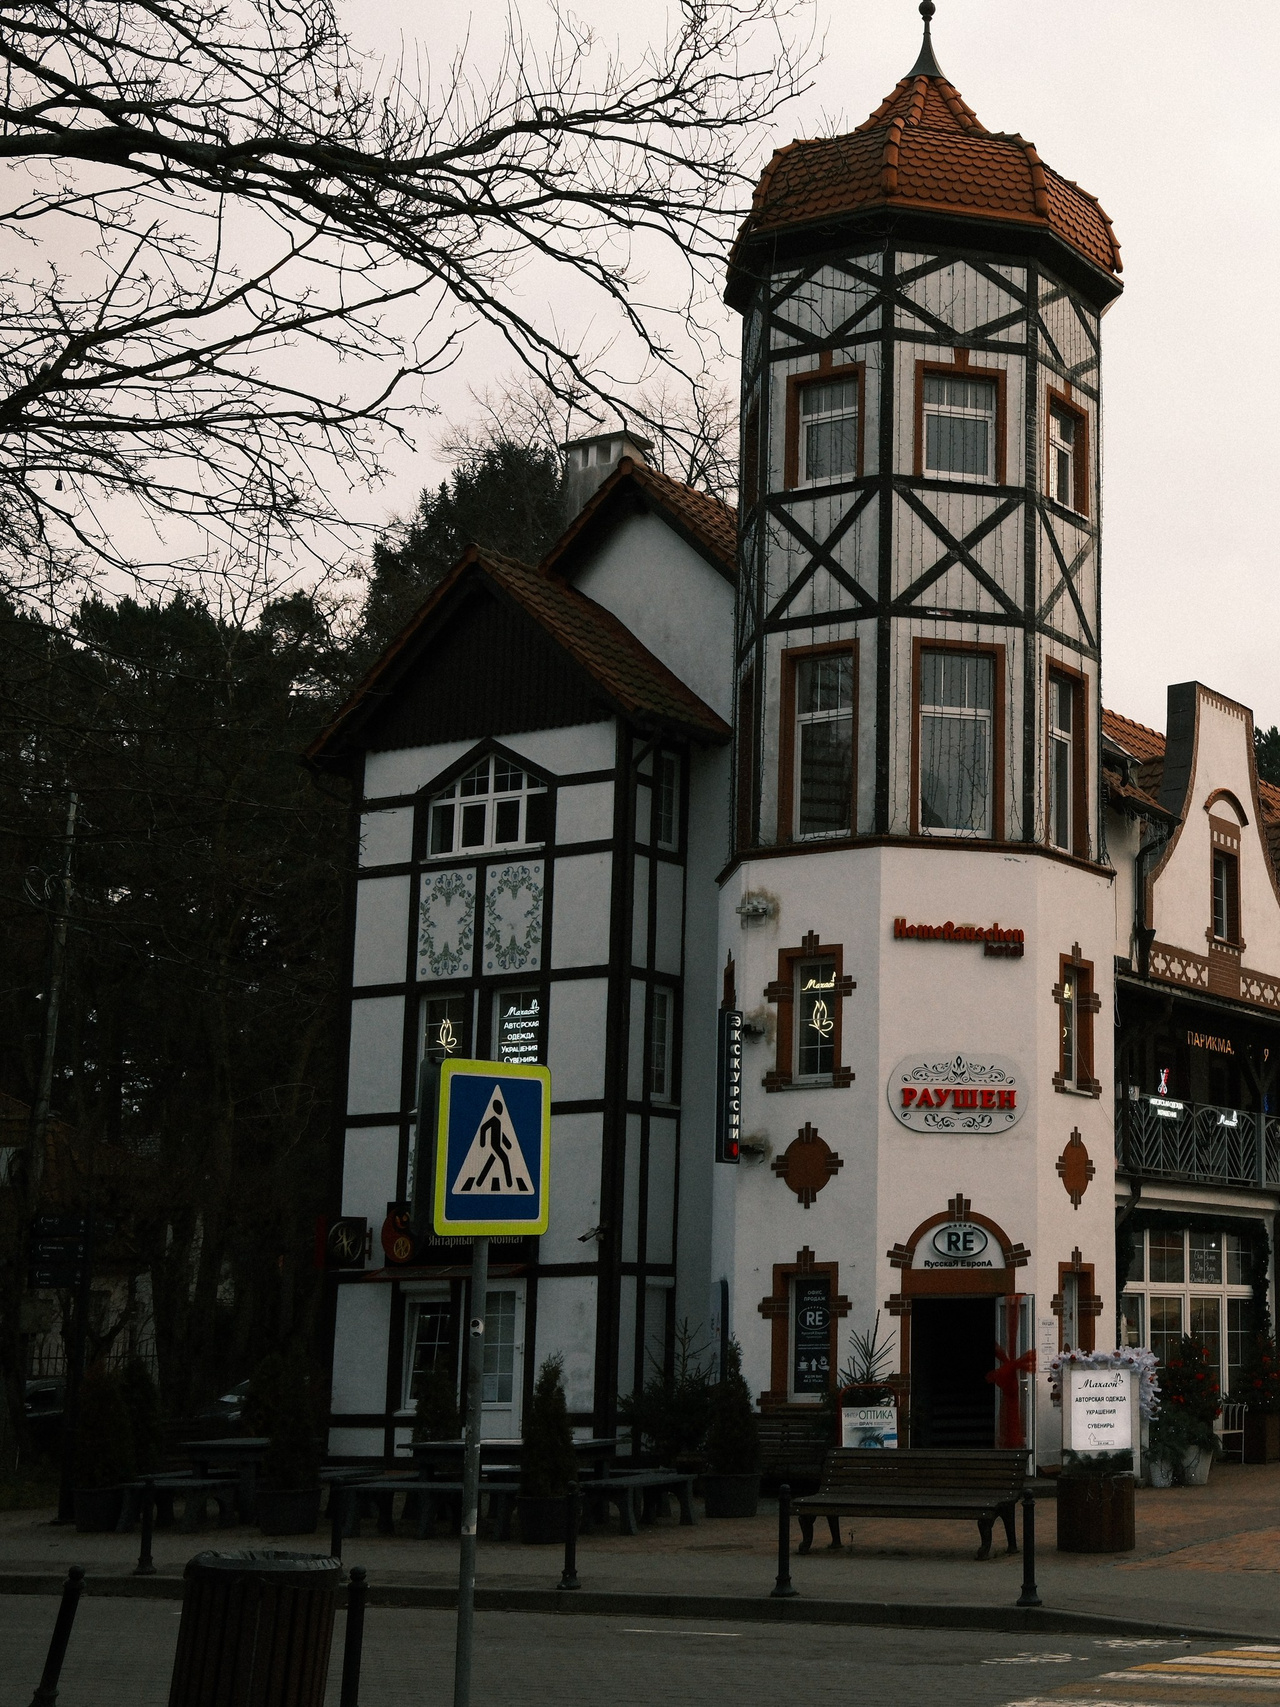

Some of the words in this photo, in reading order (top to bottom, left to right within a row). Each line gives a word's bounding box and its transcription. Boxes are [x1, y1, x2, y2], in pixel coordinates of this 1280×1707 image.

[984, 942, 1024, 956] hotel
[730, 1015, 741, 1139] ЭКСКУРСИИ
[901, 1087, 1017, 1109] РАУШЕН
[947, 1231, 974, 1252] RE
[806, 1311, 823, 1326] RE
[1078, 1379, 1118, 1389] Махаон
[859, 1410, 894, 1420] ОПТИКА
